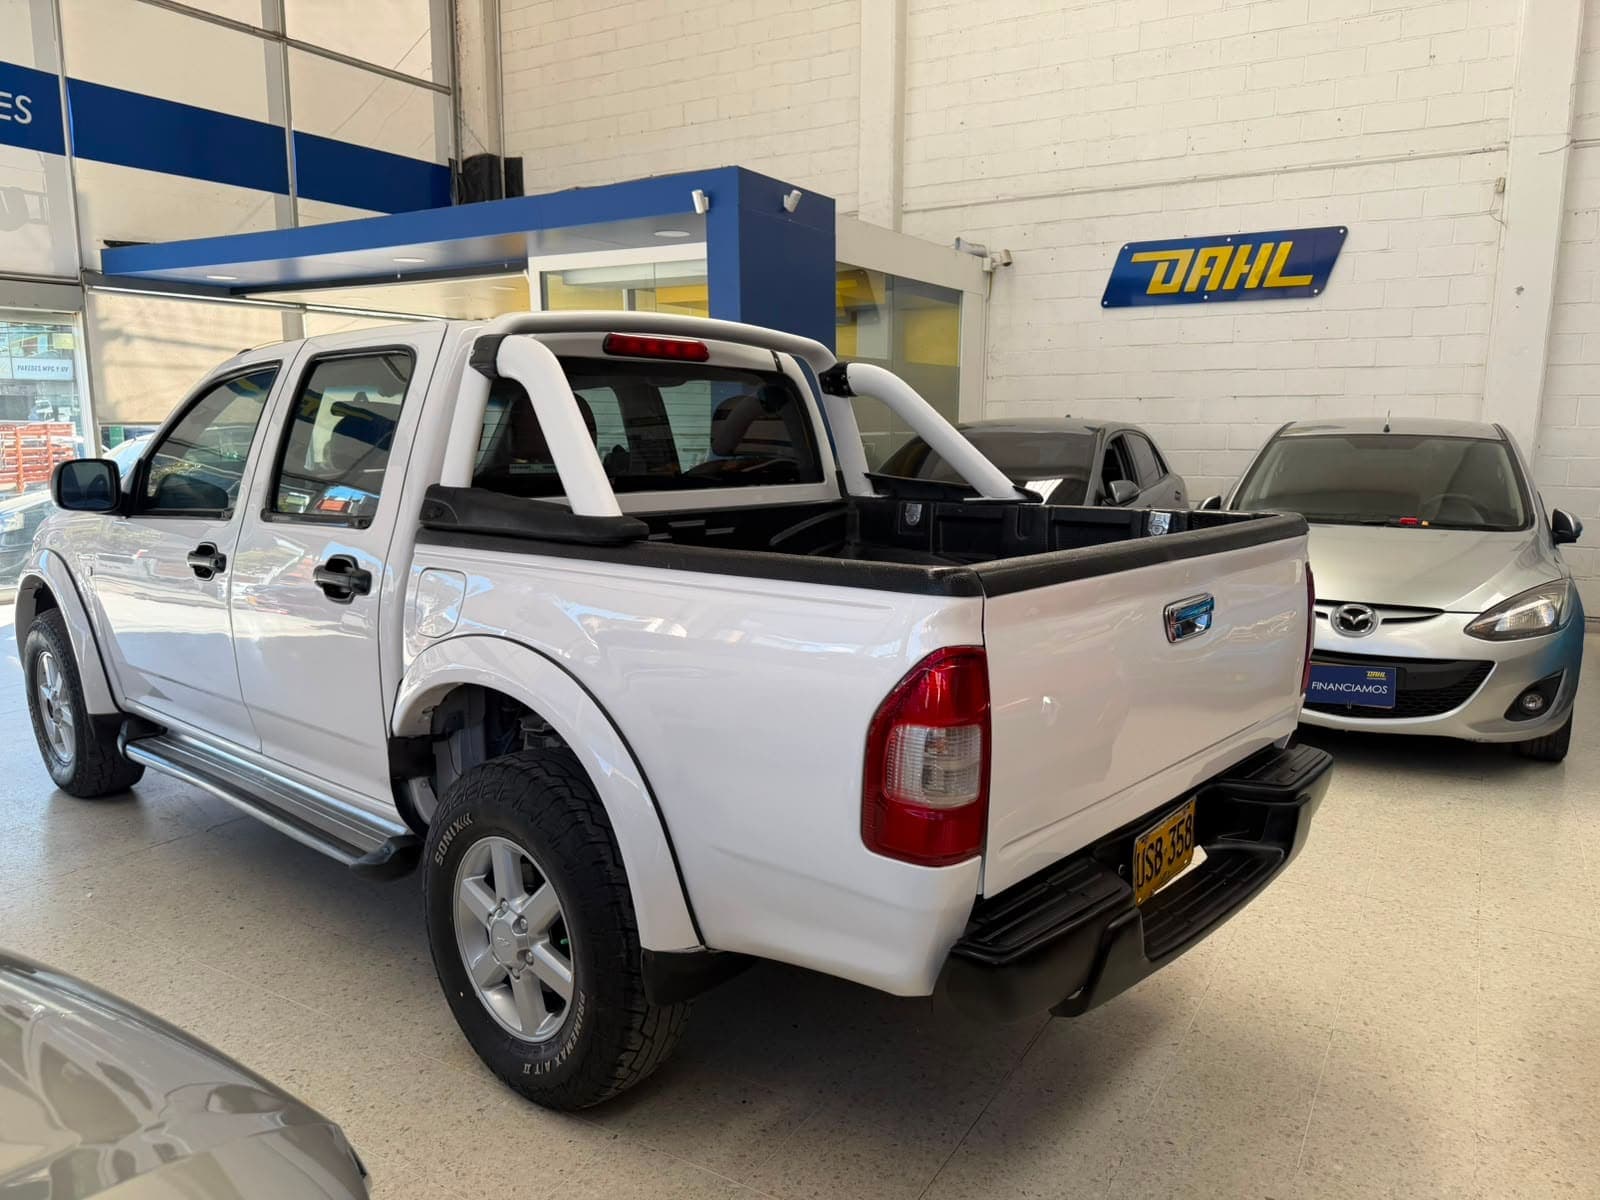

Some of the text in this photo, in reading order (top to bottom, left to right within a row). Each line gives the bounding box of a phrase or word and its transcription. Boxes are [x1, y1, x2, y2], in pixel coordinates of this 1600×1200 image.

[1131, 241, 1314, 295] DAHL
[1311, 681, 1389, 695] FINANCIAMOS
[434, 816, 464, 866] SONIX
[1168, 813, 1193, 865] 358
[554, 990, 586, 1067] PRIMEMAX
